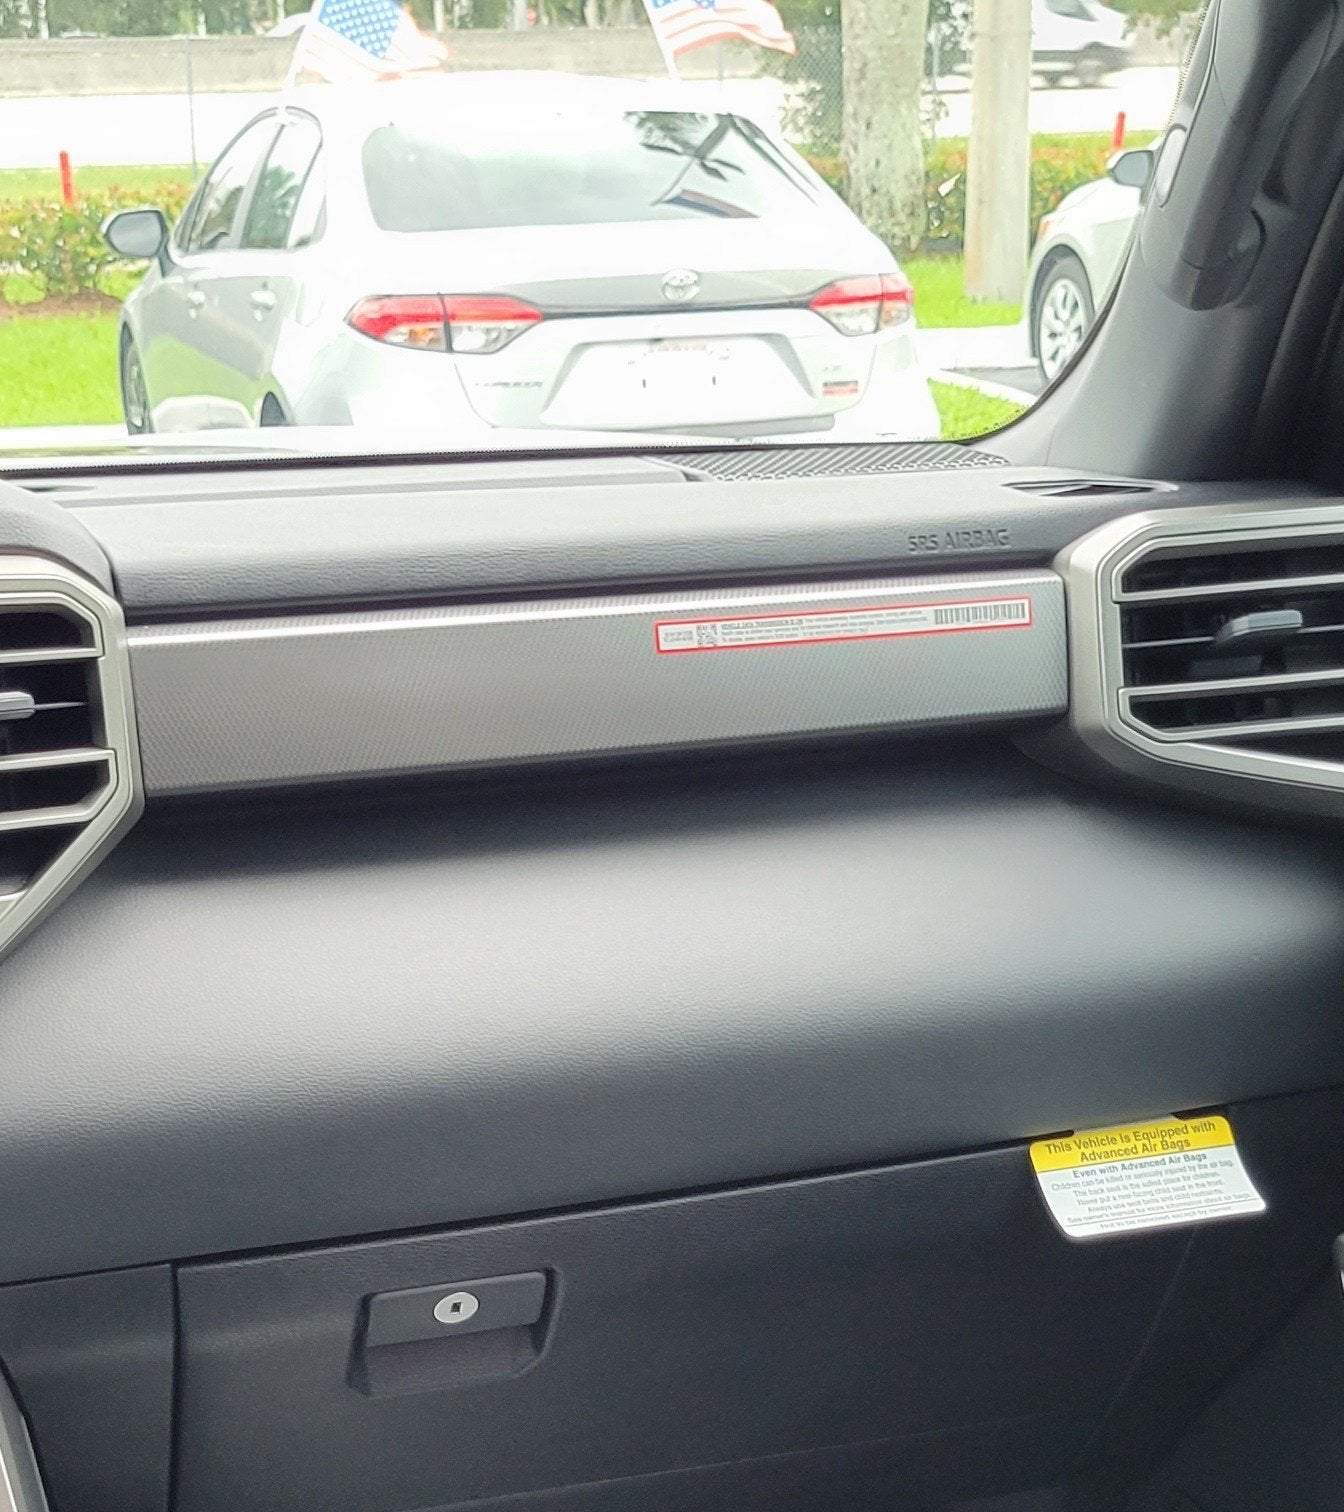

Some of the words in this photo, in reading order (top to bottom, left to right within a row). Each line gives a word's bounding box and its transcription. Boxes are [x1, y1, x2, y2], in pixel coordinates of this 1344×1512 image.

[908, 533, 939, 553] SRS
[945, 529, 1012, 551] AIRBAG
[1046, 1143, 1072, 1155] This
[1073, 1135, 1118, 1150] Vehicle
[1133, 1124, 1189, 1144] Equipped
[1191, 1121, 1216, 1134] with
[1080, 1145, 1139, 1162] Advanced
[1142, 1140, 1157, 1153] Air
[1162, 1138, 1191, 1151] Bags
[1073, 1168, 1097, 1179] Even
[1099, 1164, 1119, 1175] with
[1121, 1157, 1167, 1172] Advanced
[1168, 1155, 1181, 1165] Air
[1183, 1152, 1207, 1163] Bags
